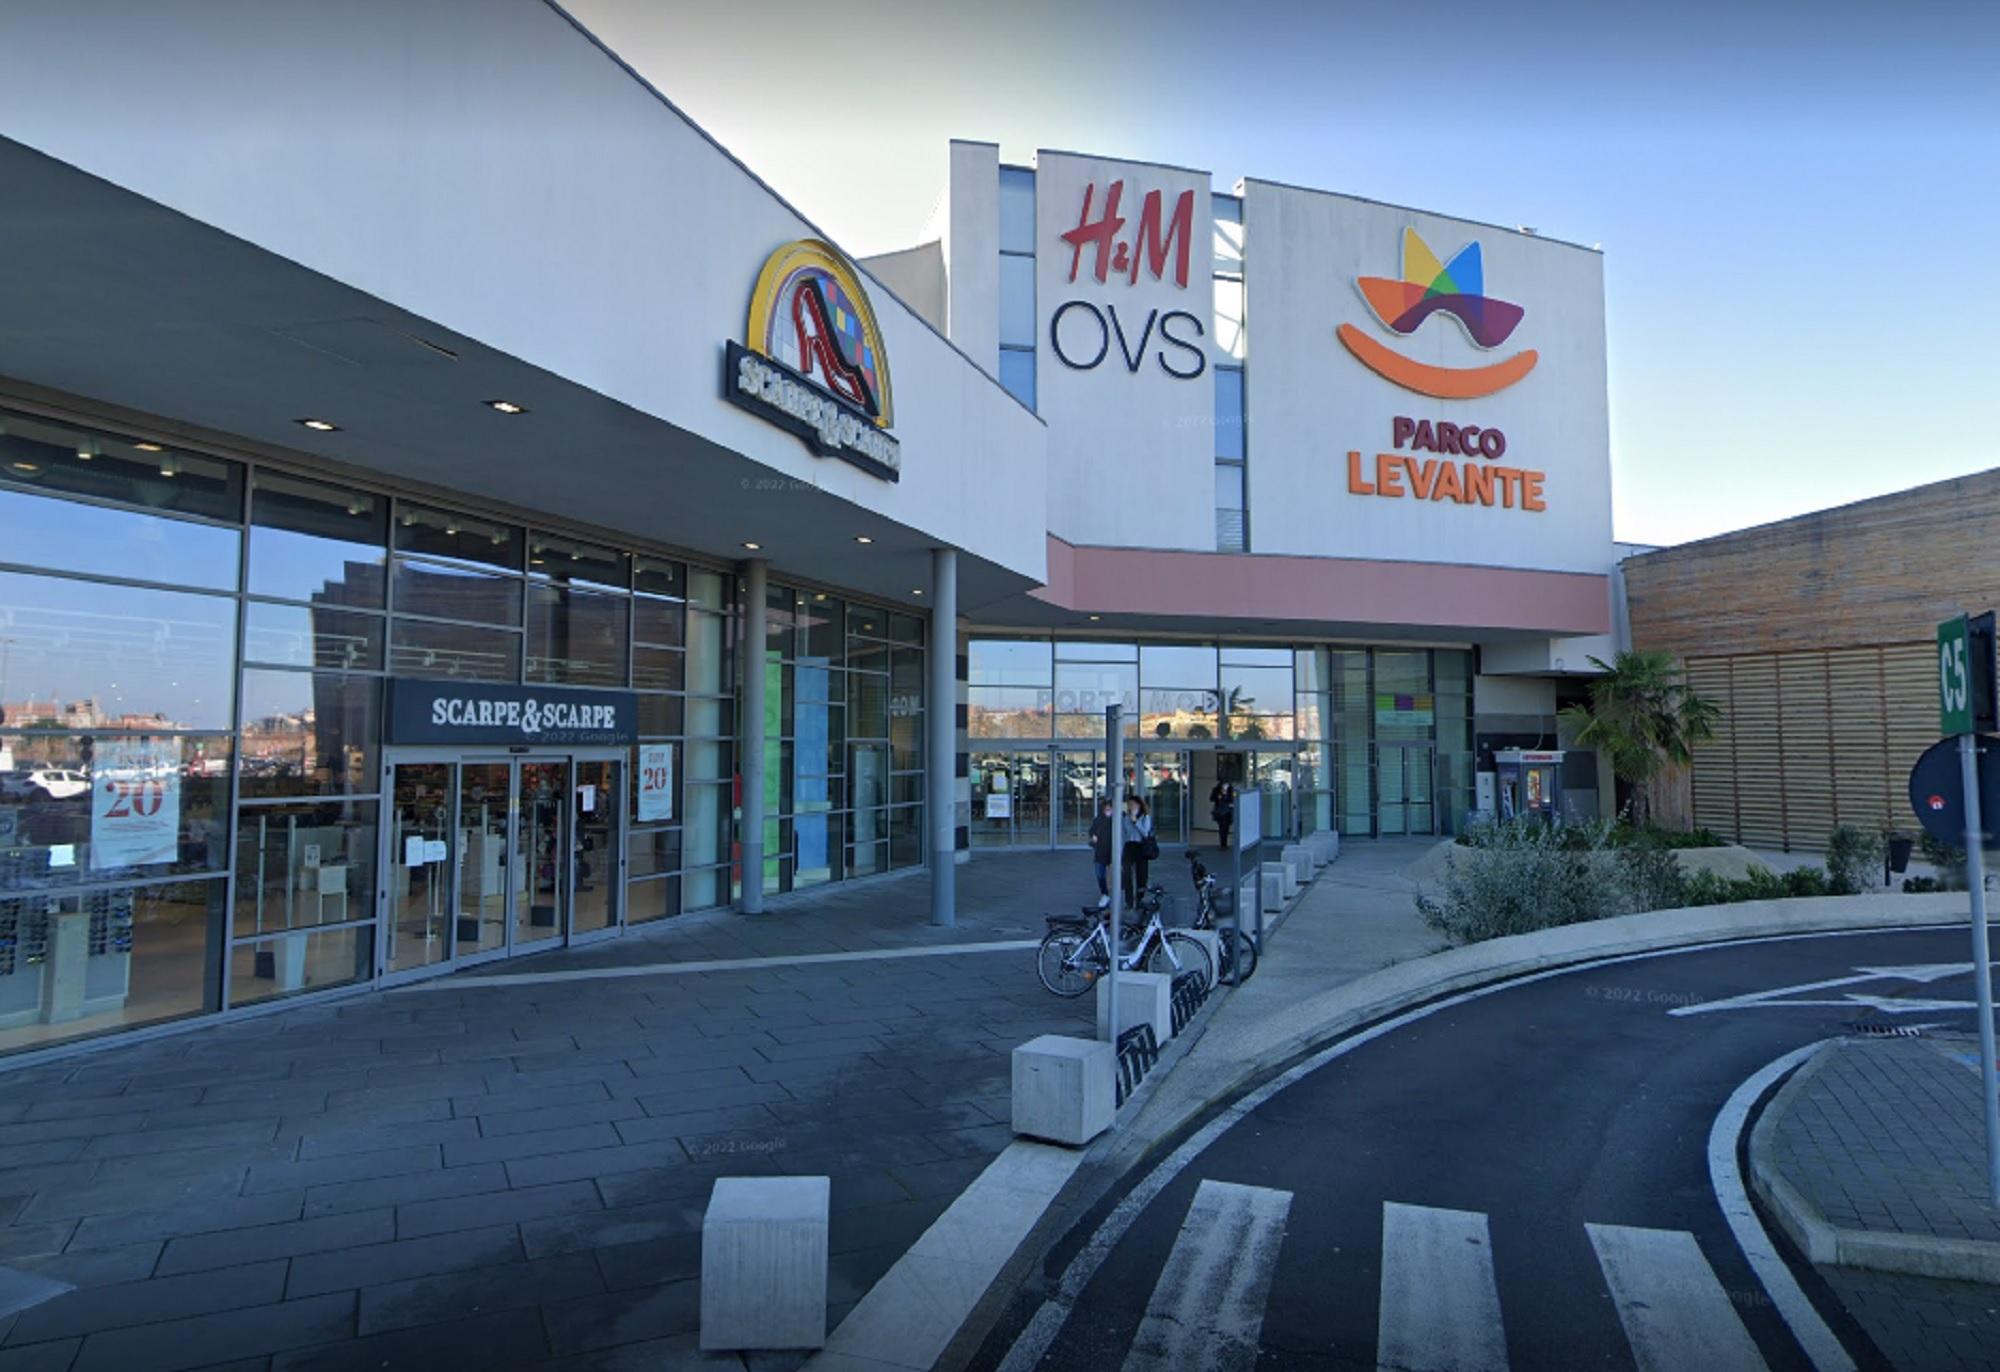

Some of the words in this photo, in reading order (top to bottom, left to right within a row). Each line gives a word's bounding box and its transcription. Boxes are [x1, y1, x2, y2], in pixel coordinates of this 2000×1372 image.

[1060, 179, 1194, 289] H&M
[1050, 299, 1206, 380] OVS
[1393, 415, 1506, 460] PARCO
[1347, 450, 1546, 512] LEVANTE
[1940, 638, 1967, 713] C5
[432, 697, 615, 733] SCARPE&SCARPE
[103, 779, 163, 818] 20
[643, 767, 667, 792] 20
